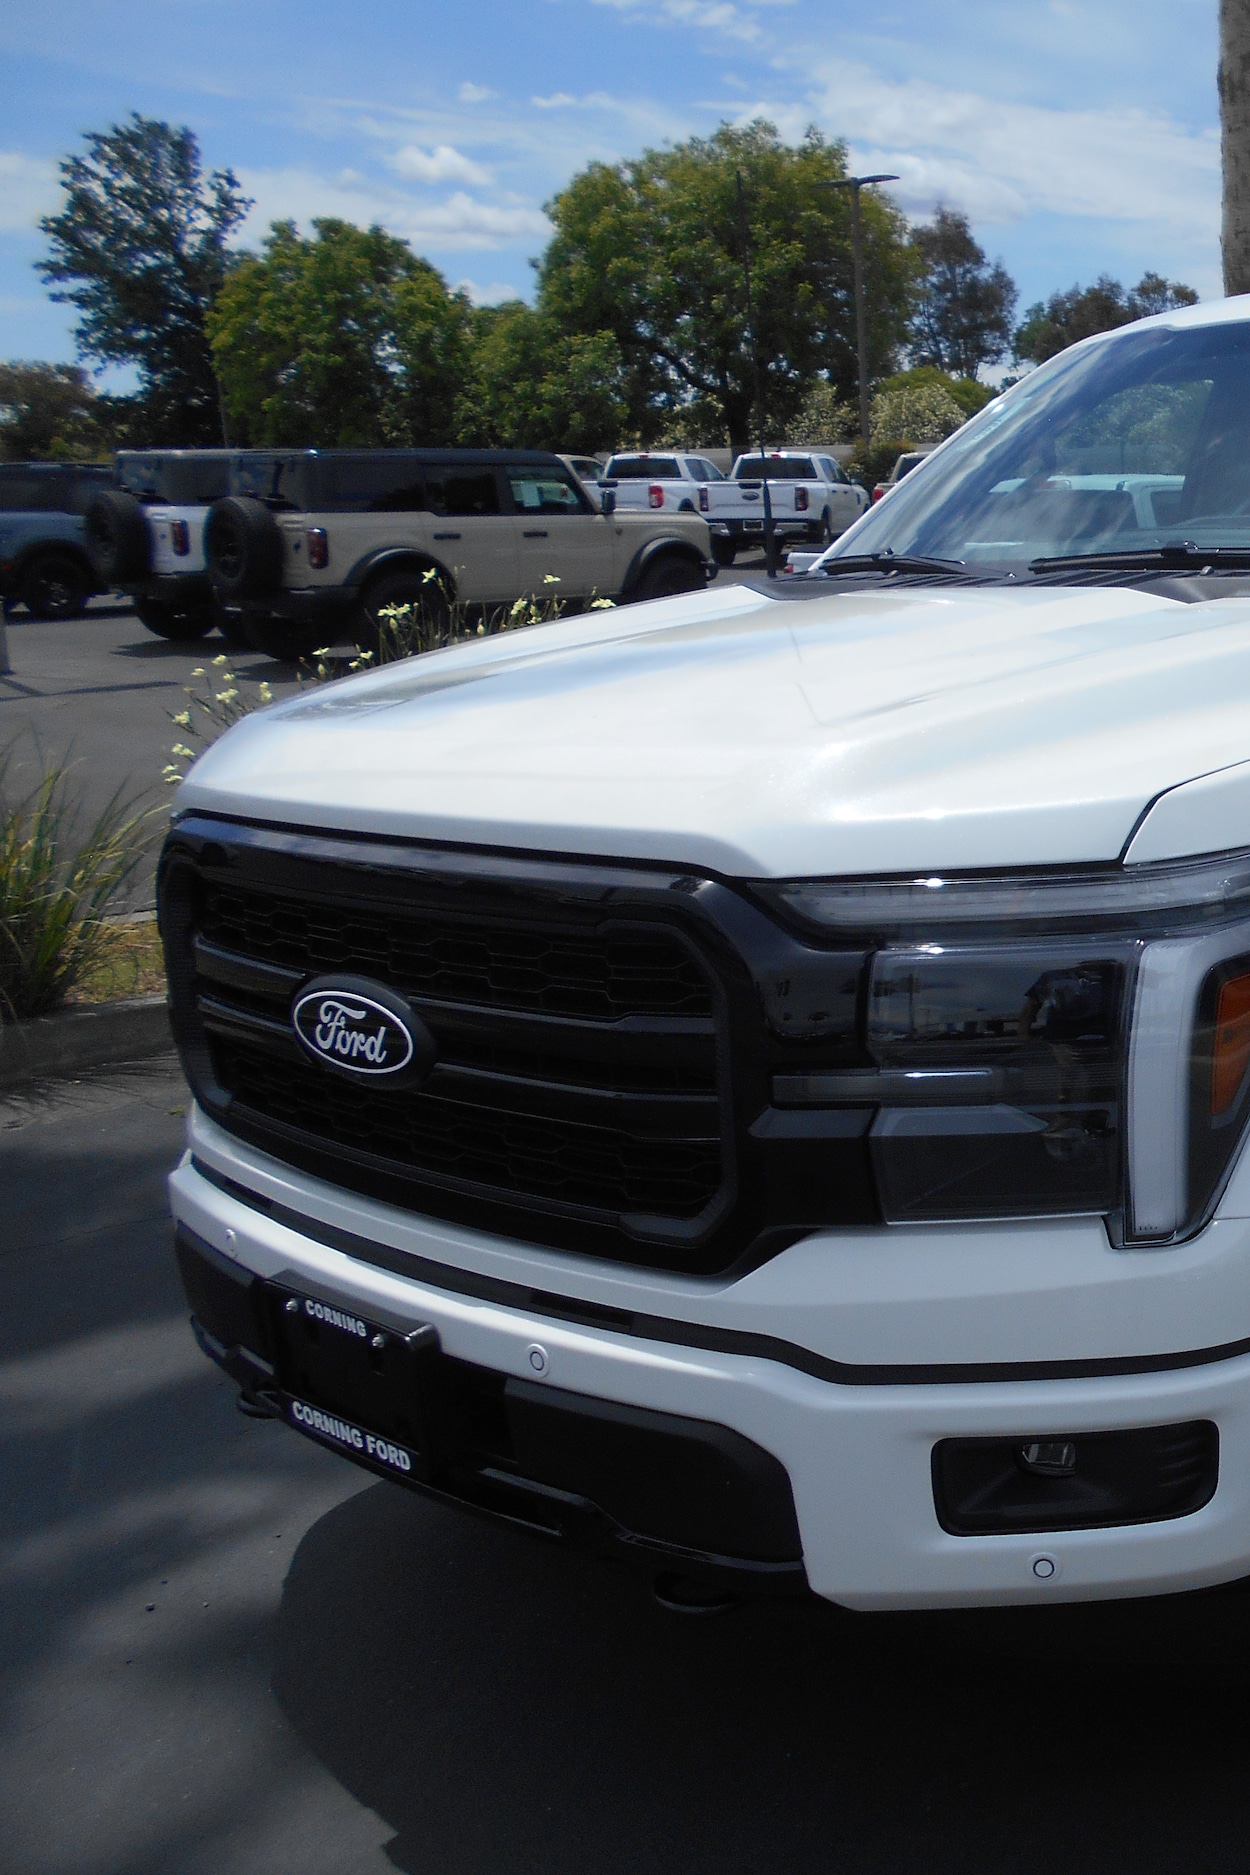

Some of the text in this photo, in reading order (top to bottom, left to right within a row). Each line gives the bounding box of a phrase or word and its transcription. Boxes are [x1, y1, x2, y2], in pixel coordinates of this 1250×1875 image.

[315, 1000, 388, 1063] Ford
[305, 1299, 367, 1337] CORNING
[292, 1400, 411, 1470] CORNING FORD
